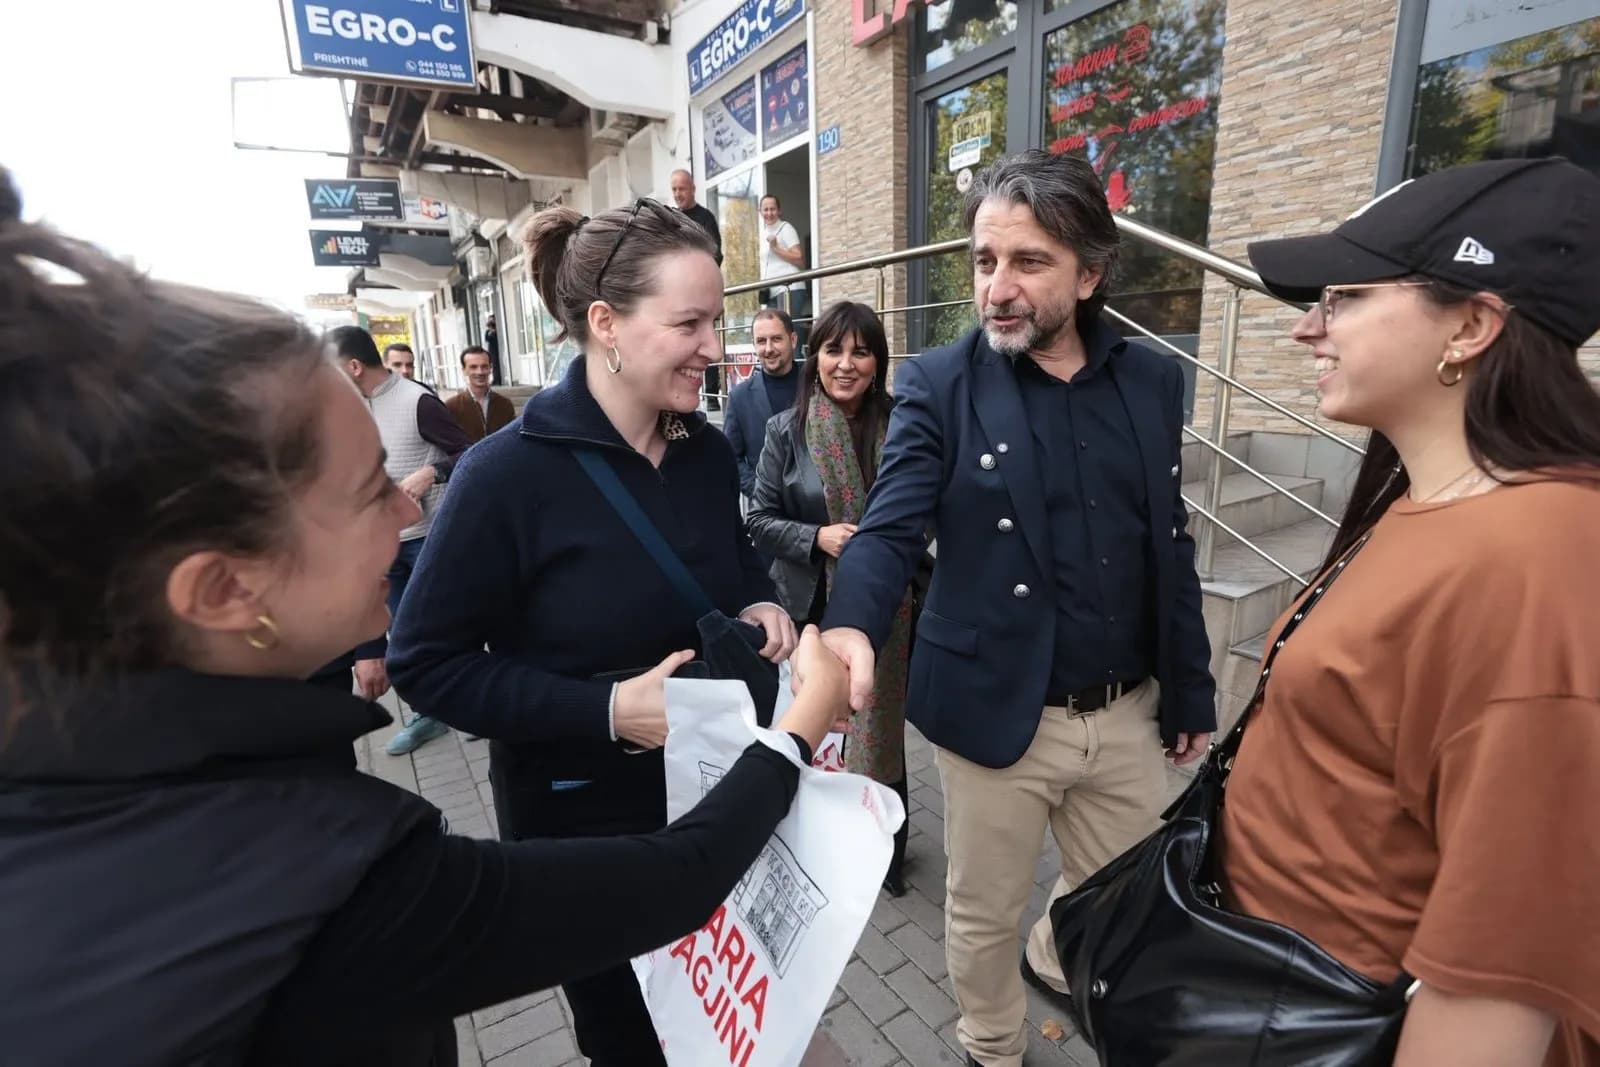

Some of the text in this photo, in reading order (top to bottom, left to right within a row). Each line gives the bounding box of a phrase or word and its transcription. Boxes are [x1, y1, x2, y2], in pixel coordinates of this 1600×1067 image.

[304, 4, 457, 52] EGRO-C
[699, 0, 772, 80] EGRO-C
[1053, 44, 1120, 87] SOLARIUM
[818, 129, 838, 153] 190
[336, 236, 370, 246] LEVEL
[338, 245, 368, 255] TECH
